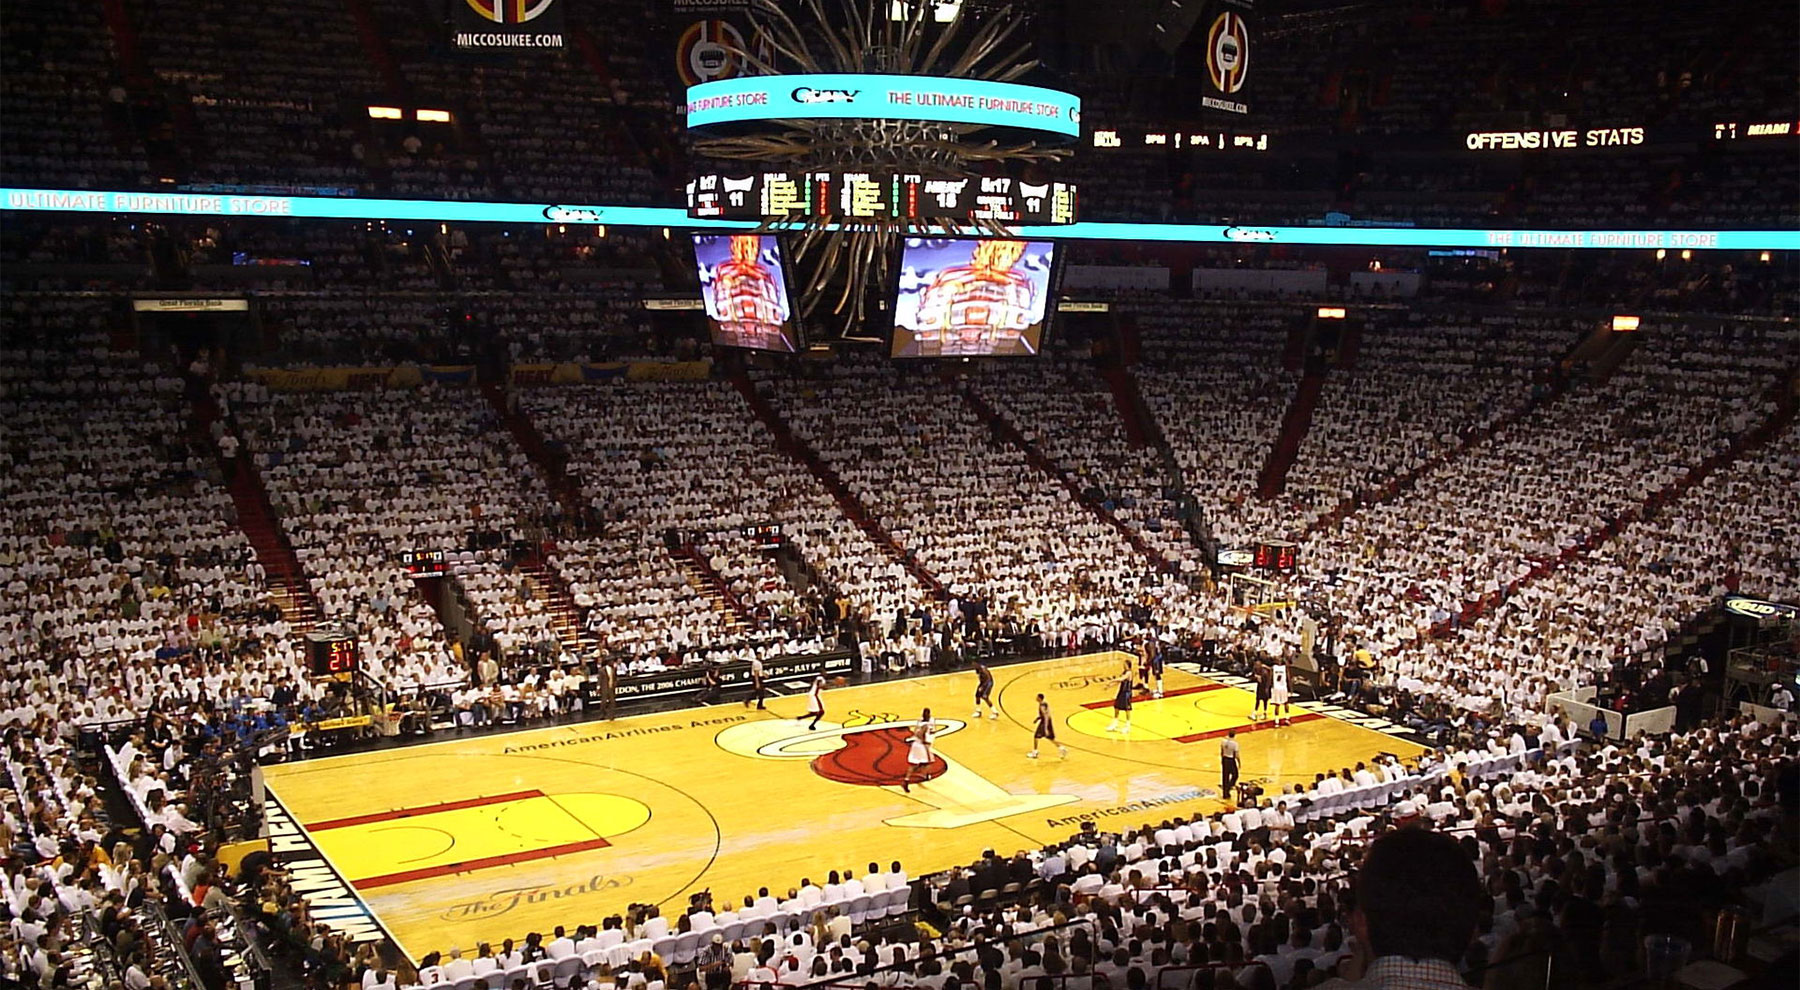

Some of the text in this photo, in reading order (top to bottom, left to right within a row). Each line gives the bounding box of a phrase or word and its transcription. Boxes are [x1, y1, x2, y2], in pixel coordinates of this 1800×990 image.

[457, 33, 562, 47] MICCOSUKEE.COM
[736, 92, 768, 106] STORE
[889, 92, 1059, 118] THE ULTIMATE FURNITURE STORE
[1747, 123, 1790, 135] MIAMI
[1586, 127, 1644, 147] STATS
[11, 193, 290, 214] ULTIMATE FURNITURE STORE
[729, 191, 743, 206] 11
[1026, 198, 1040, 212] 11
[1489, 233, 1716, 247] THE ULTIMATE FURNITURE STORE
[331, 640, 353, 652] 5:17
[330, 652, 350, 670] 21
[641, 683, 656, 692] THE
[690, 714, 747, 728] Arena
[431, 972, 439, 984] 3
